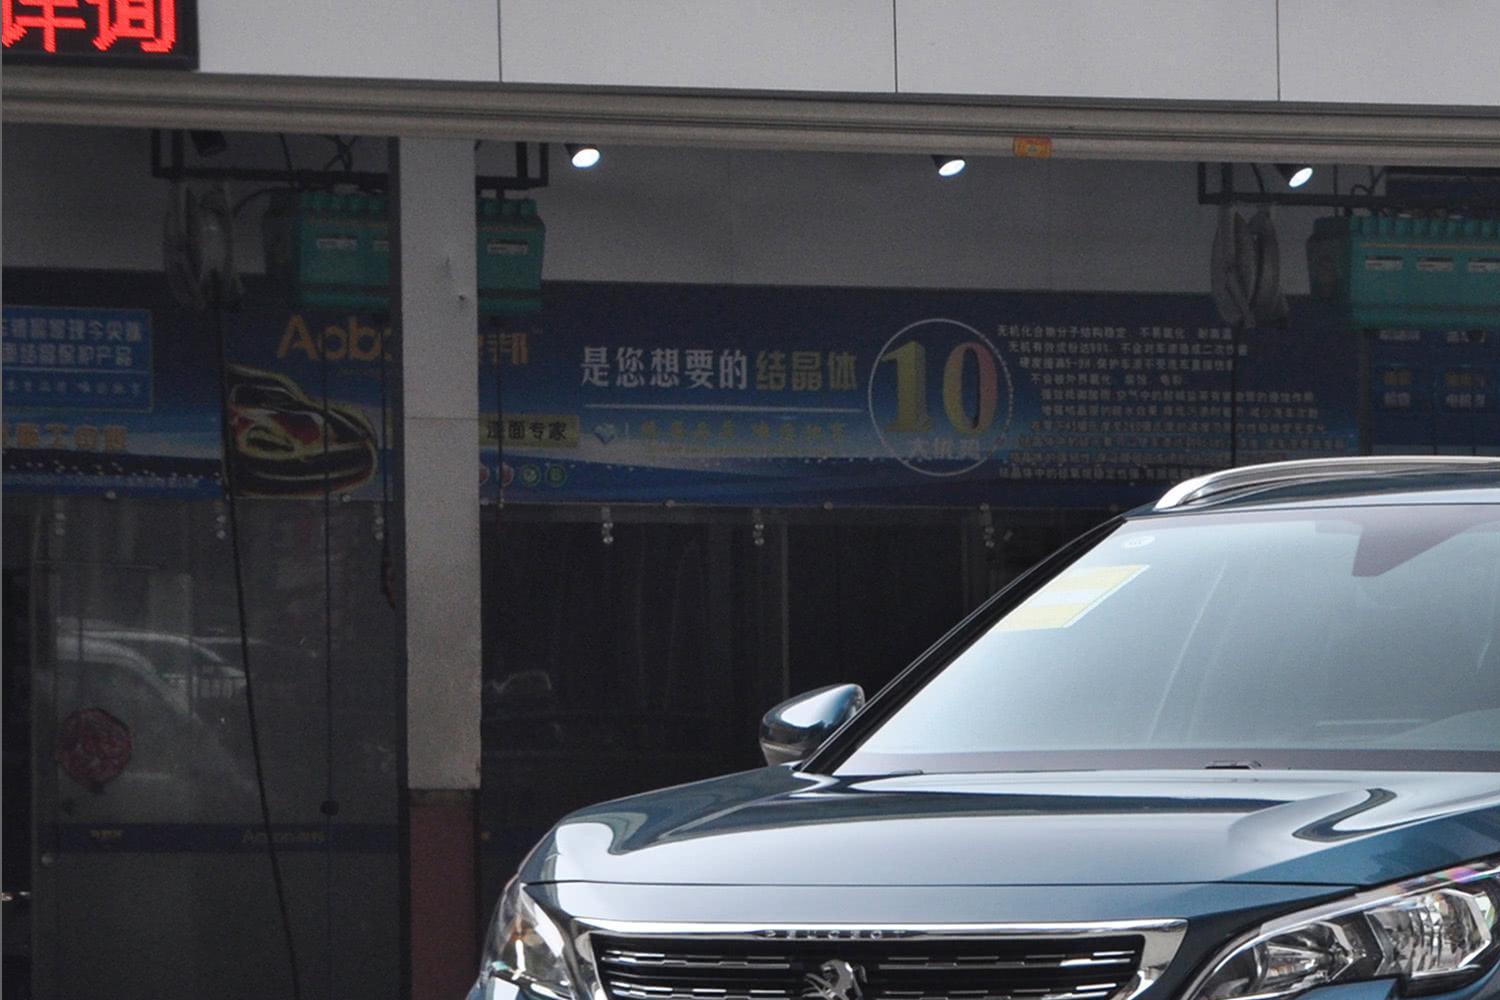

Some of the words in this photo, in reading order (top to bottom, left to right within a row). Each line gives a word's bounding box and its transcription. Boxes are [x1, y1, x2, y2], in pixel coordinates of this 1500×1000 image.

[580, 346, 858, 393] 是您想要的结晶体
[880, 339, 999, 436] 10
